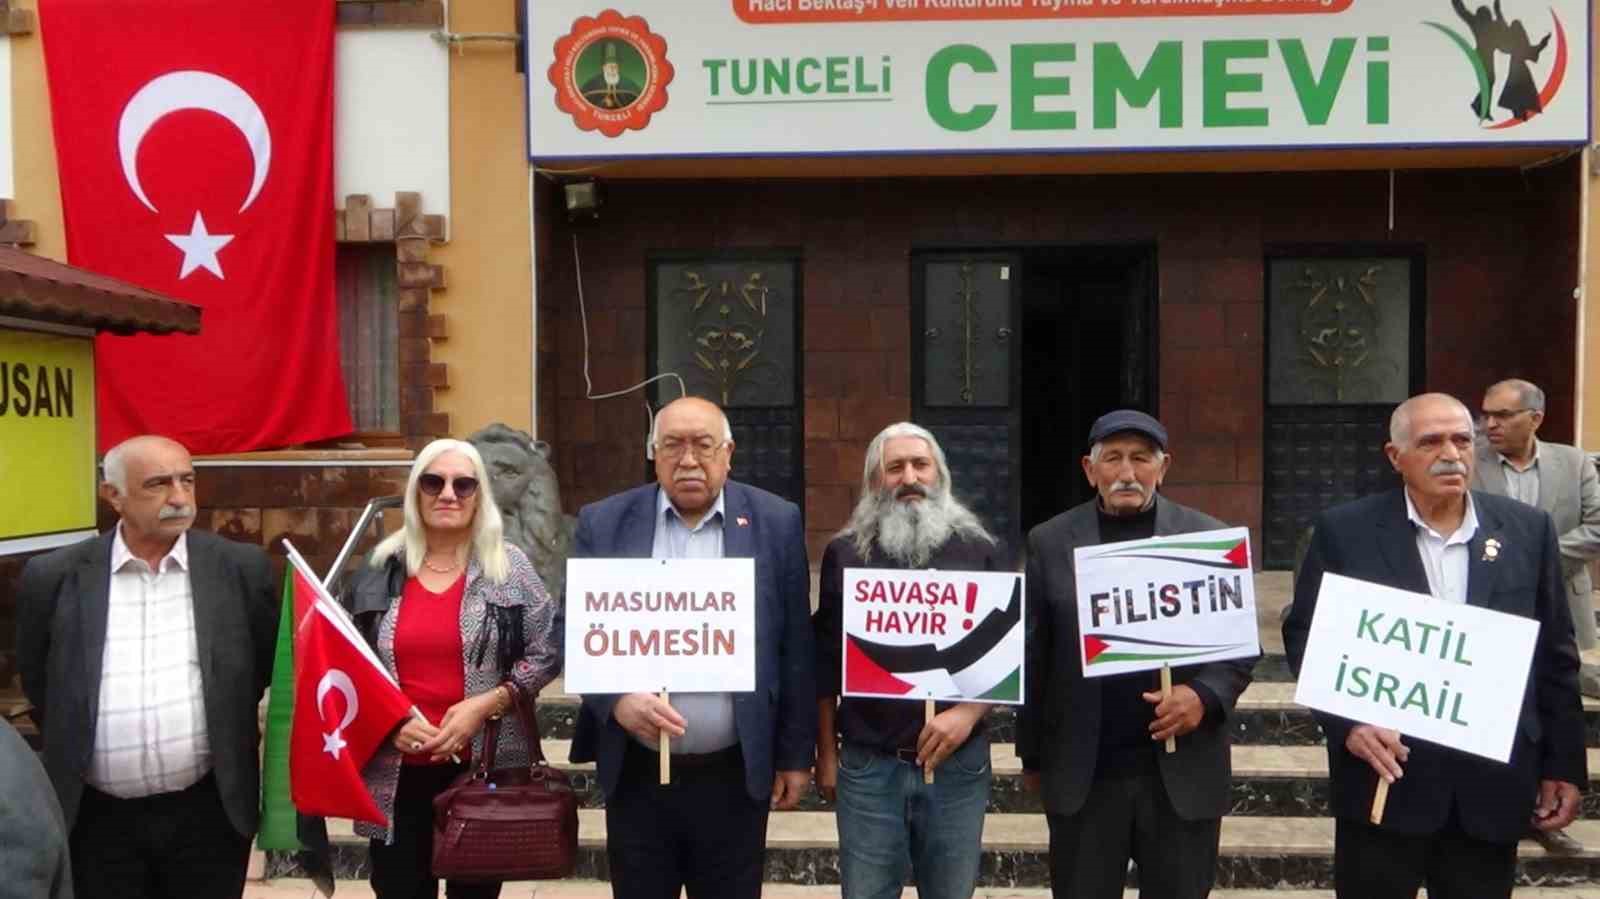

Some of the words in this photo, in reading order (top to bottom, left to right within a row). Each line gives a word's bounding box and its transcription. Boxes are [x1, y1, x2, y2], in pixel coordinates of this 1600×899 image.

[702, 56, 892, 96] TUNCELİ
[924, 36, 1391, 132] CEMEVİ
[585, 591, 737, 612] MASUMLAR
[855, 580, 958, 610] SAVAŞA
[1090, 575, 1243, 627] FİLİSTİN
[583, 622, 735, 657] ÖLMESİN
[866, 610, 947, 635] HAYIR
[1356, 609, 1472, 667] KATİL
[1334, 654, 1469, 727] İSRAİL
